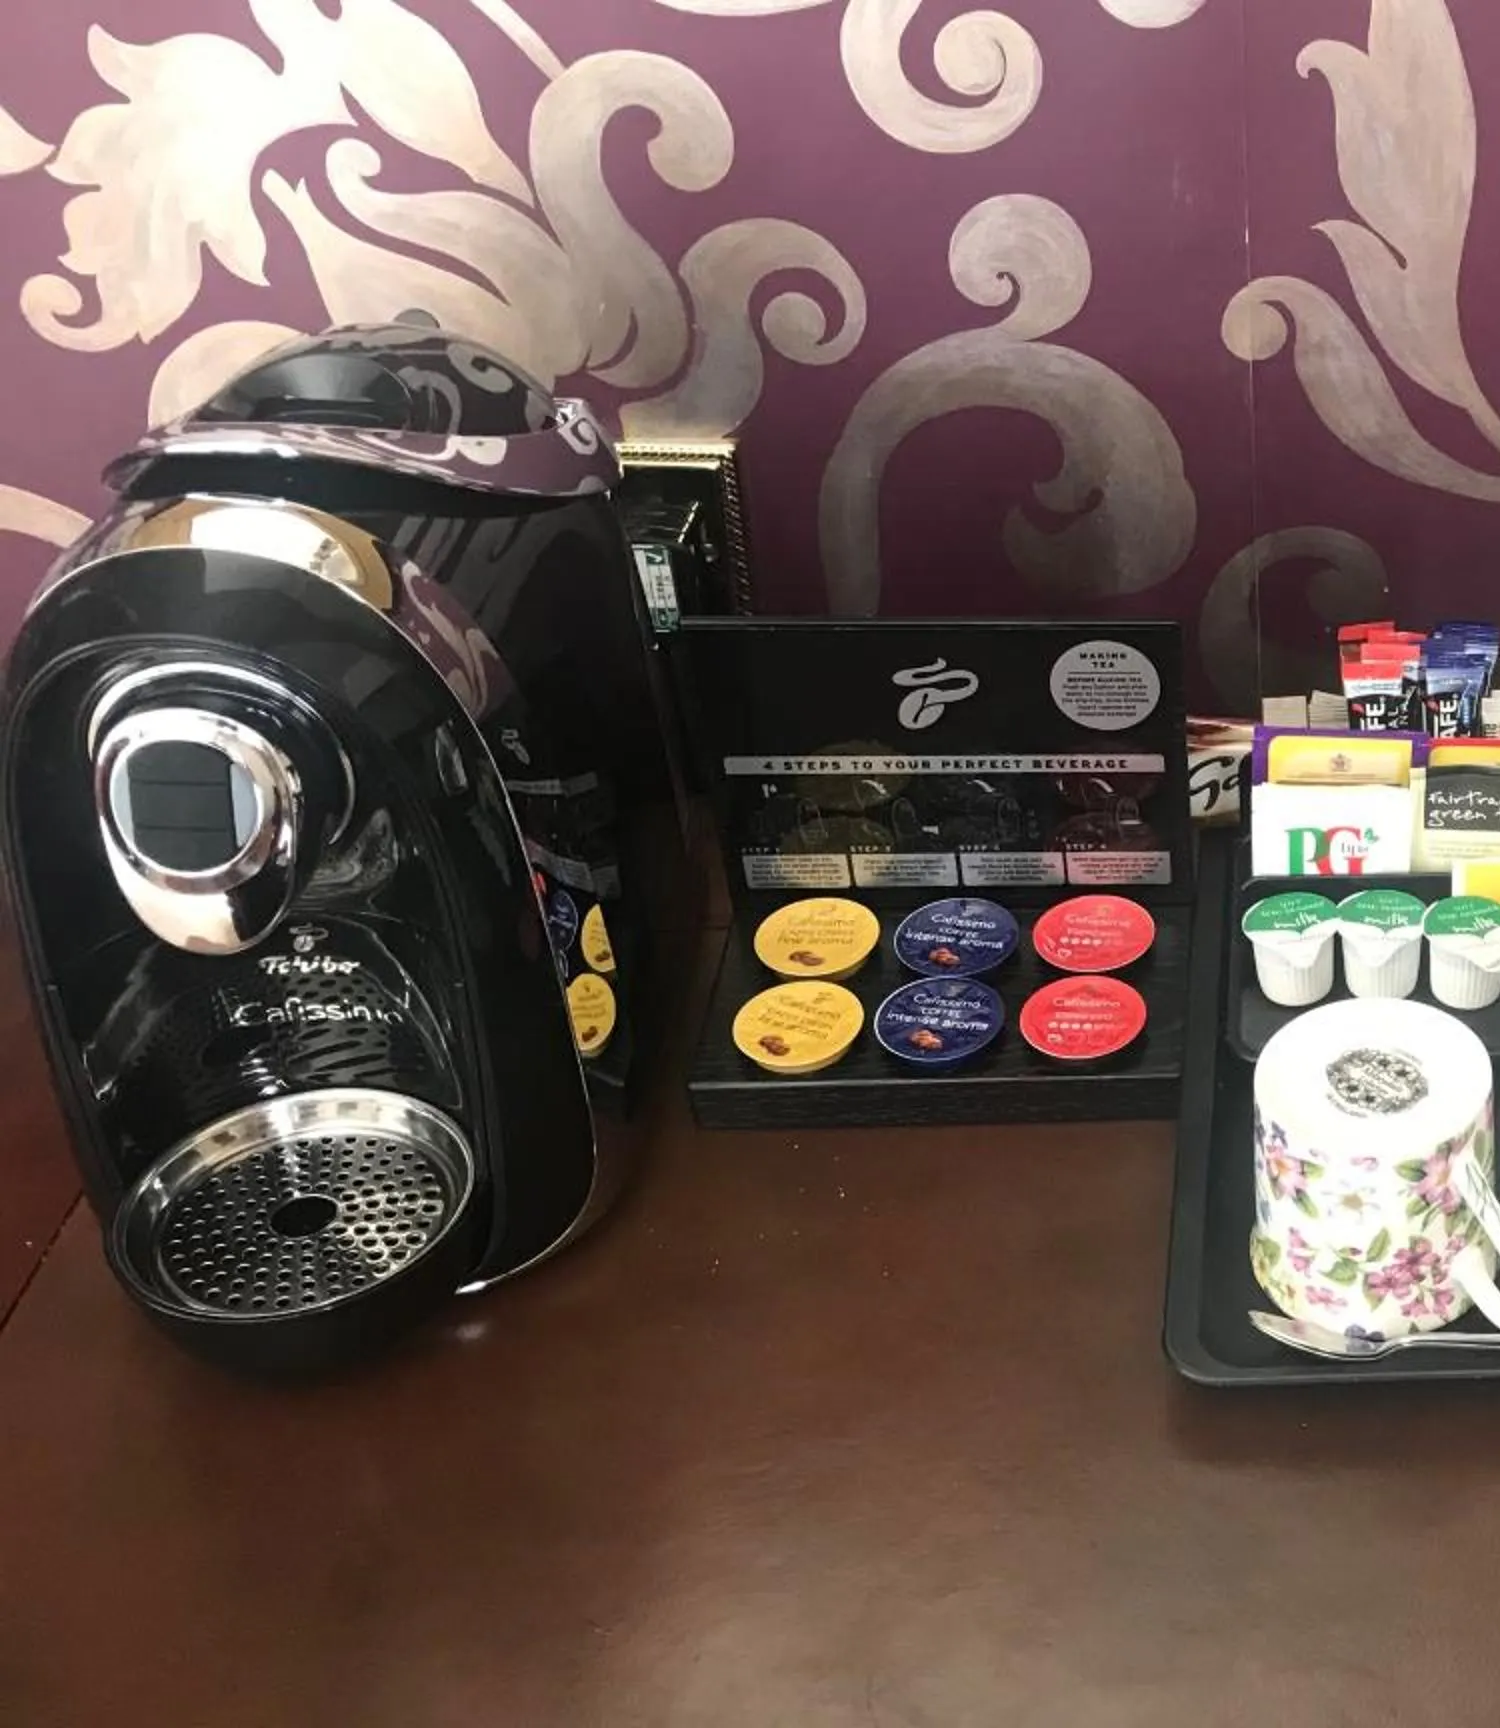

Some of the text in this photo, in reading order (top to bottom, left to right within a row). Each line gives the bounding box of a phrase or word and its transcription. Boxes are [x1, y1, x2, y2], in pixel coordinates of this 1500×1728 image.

[763, 758, 1129, 771] 4 STEPS TO YOUR PERFECT BEVERAGE
[1428, 809, 1487, 827] green
[1284, 826, 1364, 876] PG
[1274, 911, 1320, 929] milk
[1364, 911, 1409, 926] milk
[1453, 915, 1499, 933] milk
[905, 927, 1005, 950] intense aroma
[258, 955, 361, 975] Tchibo
[886, 1009, 990, 1031] intense aroma
